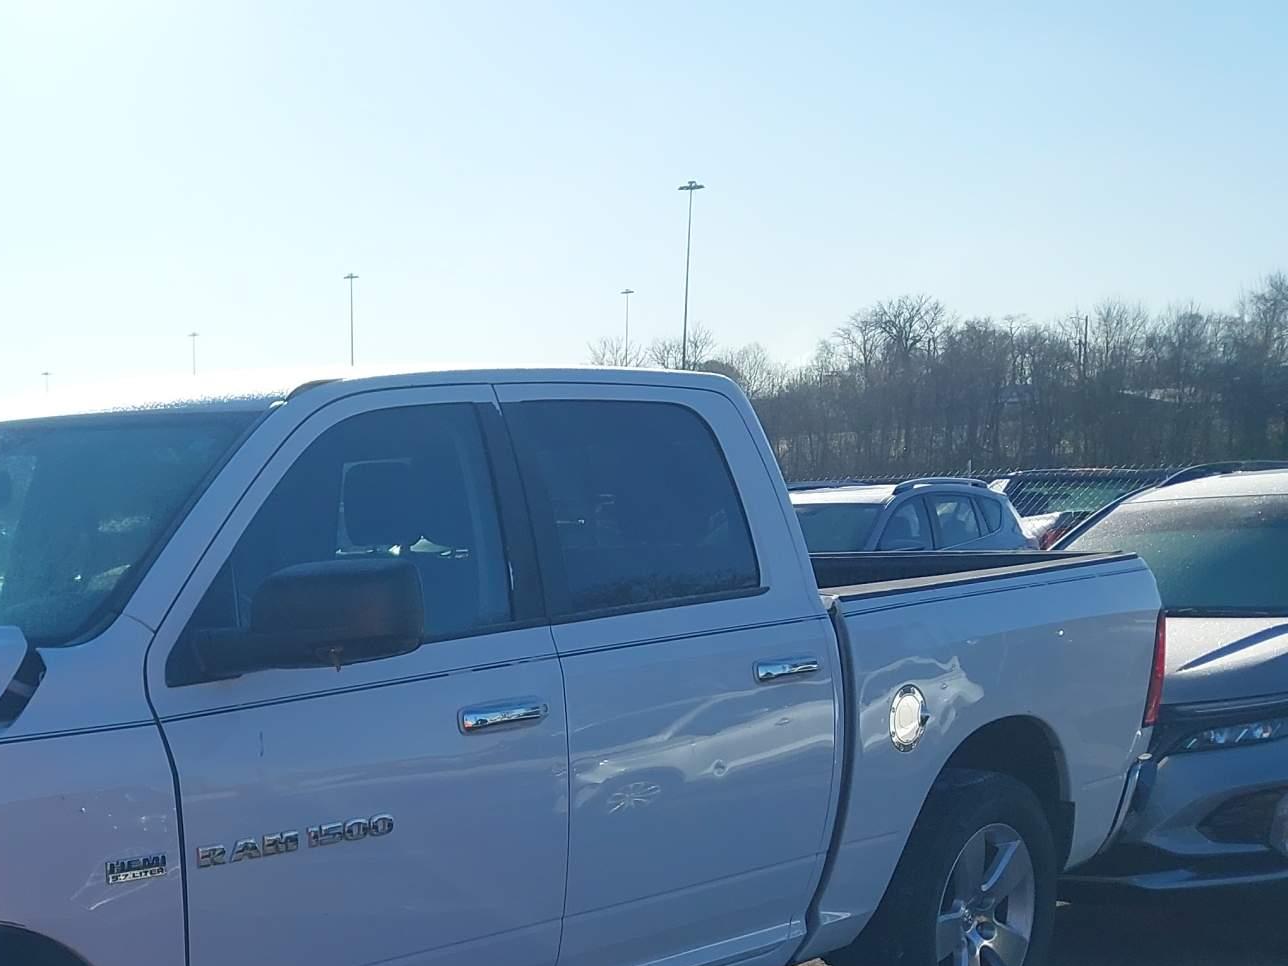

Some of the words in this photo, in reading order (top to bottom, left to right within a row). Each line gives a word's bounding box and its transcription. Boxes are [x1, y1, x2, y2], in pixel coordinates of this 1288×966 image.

[197, 830, 299, 869] RAM
[306, 813, 395, 849] 1500
[105, 855, 167, 875] HEMI
[110, 873, 129, 882] 5.7
[132, 867, 165, 879] LITER
